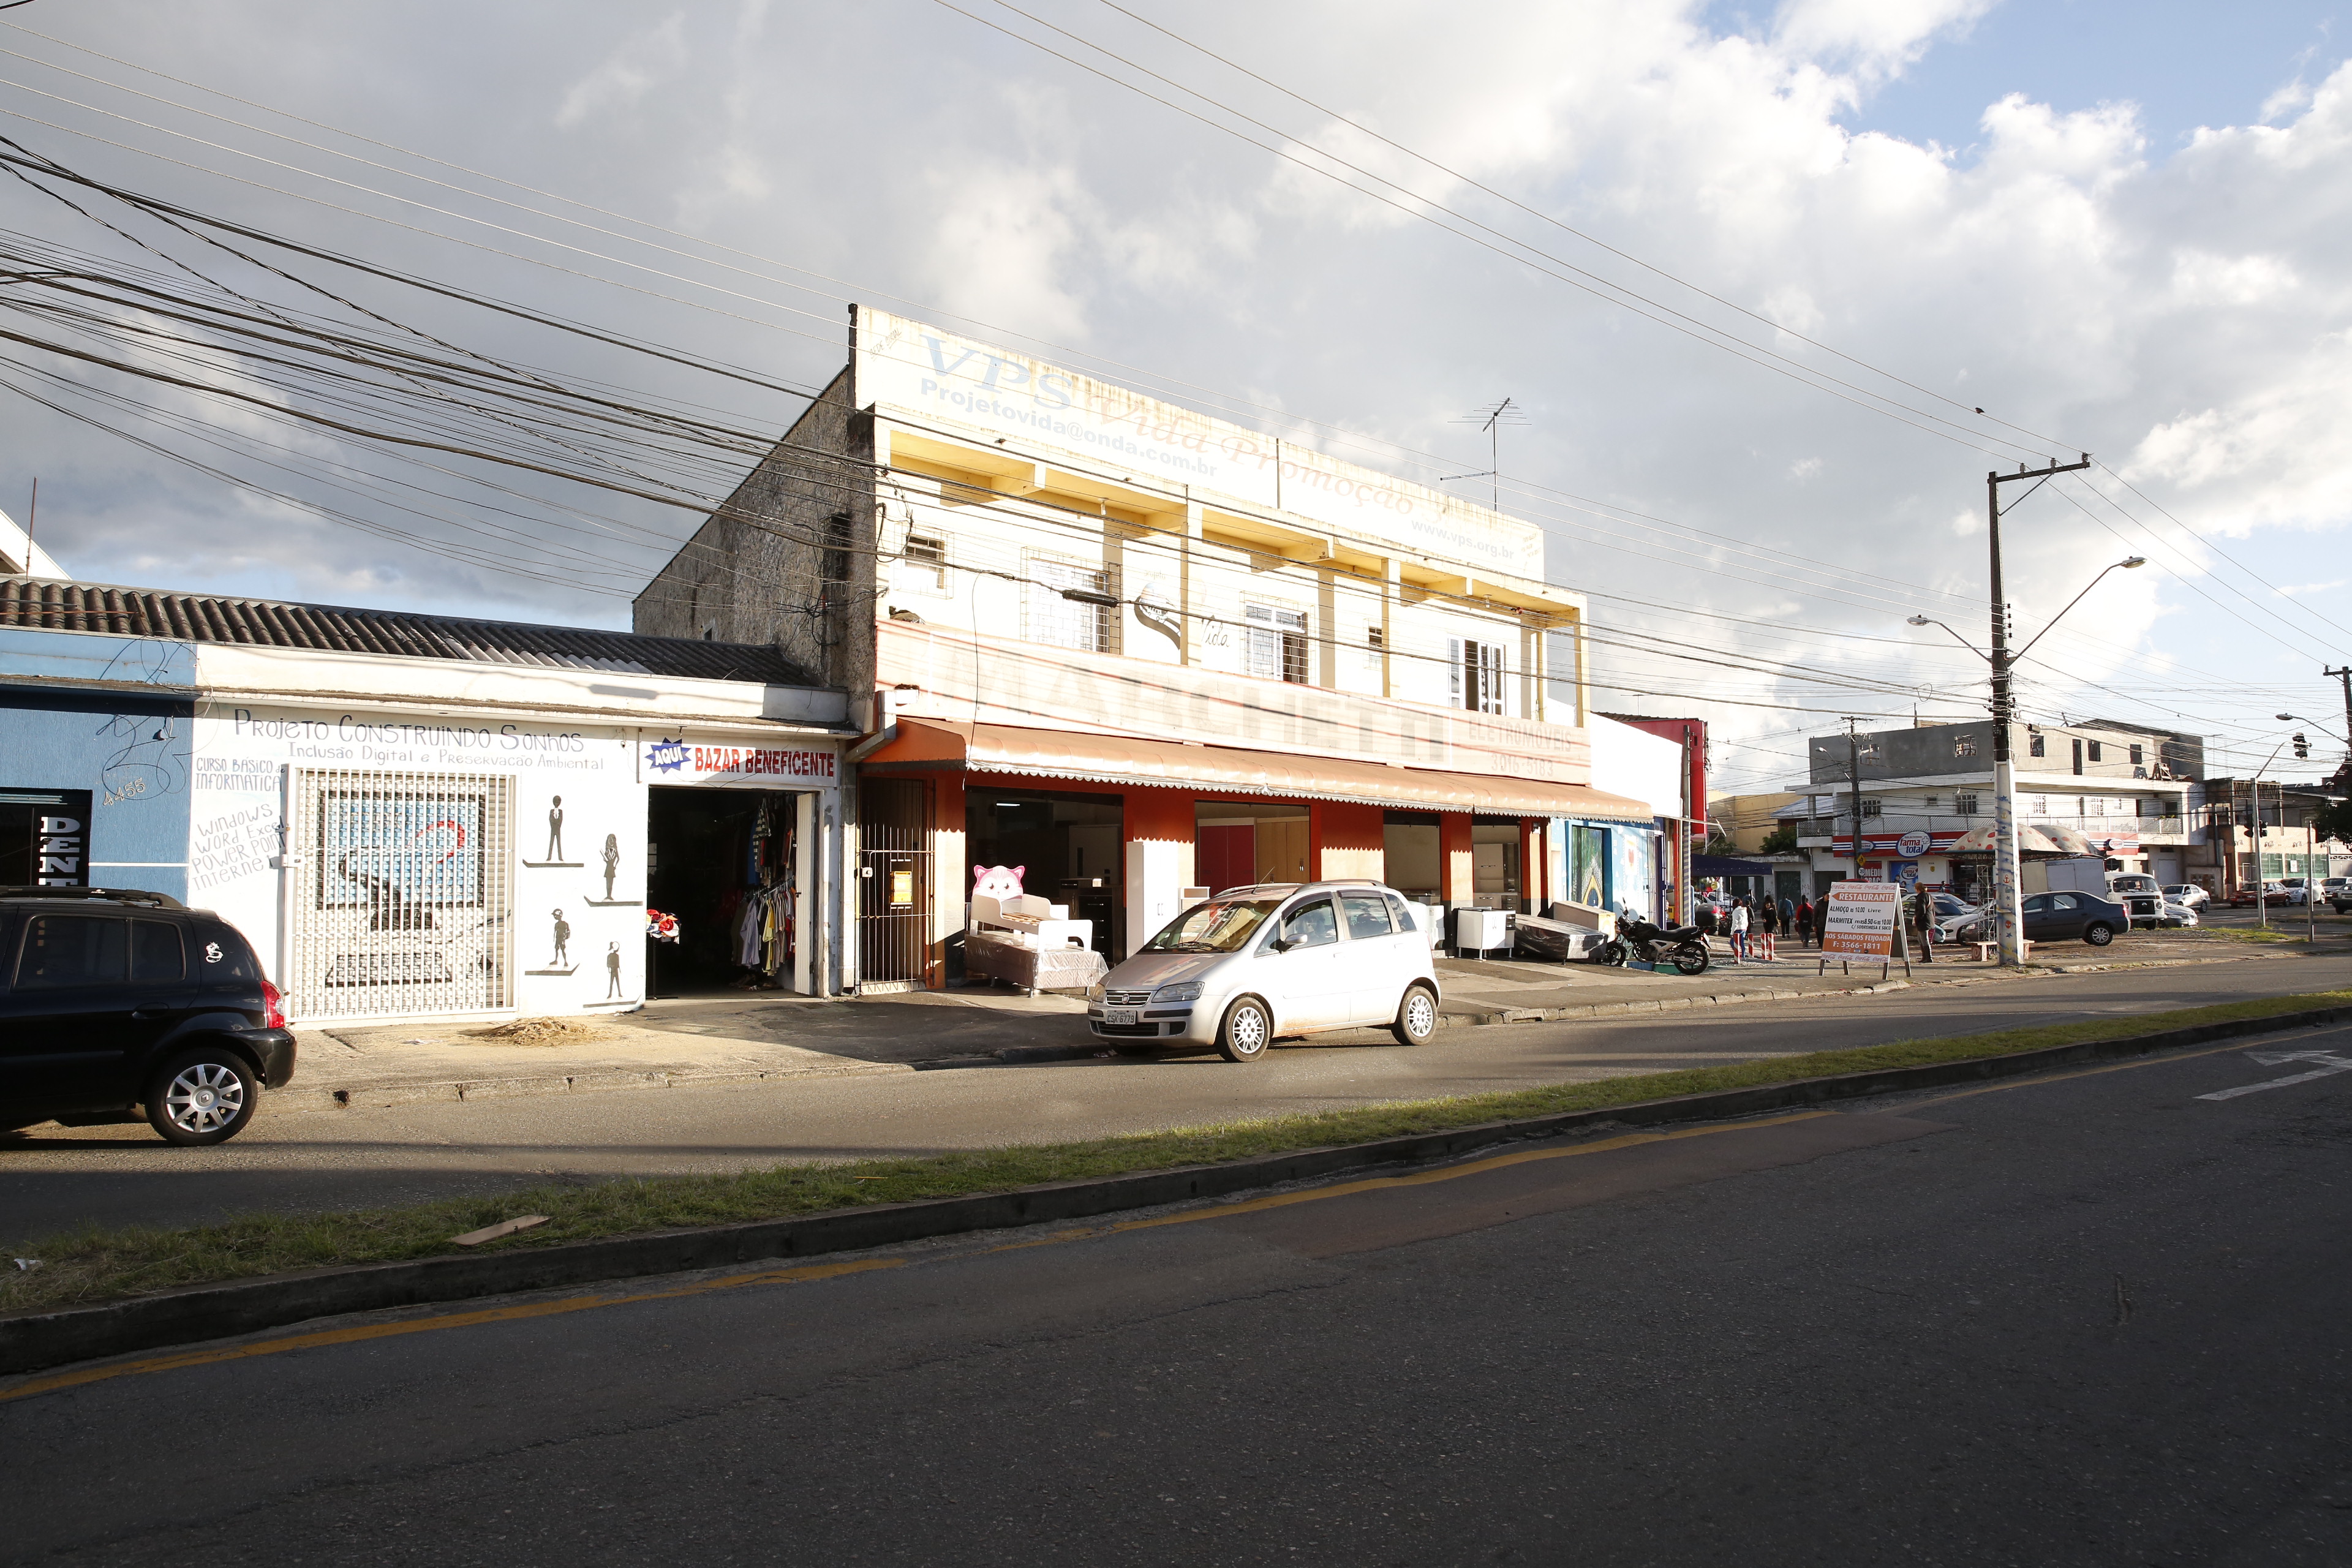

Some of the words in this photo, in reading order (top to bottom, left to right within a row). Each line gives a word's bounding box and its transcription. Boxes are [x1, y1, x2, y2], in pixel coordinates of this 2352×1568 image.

[919, 333, 1073, 410] VPS
[1087, 395, 1208, 453] Vida
[1221, 436, 1414, 514] Promoção
[921, 378, 1218, 477] Projetovida@onda.com.br
[1411, 519, 1514, 559] www.vps.org.br
[1468, 717, 1572, 753] ELETROMÓVEIS
[197, 758, 227, 772] CURSO
[288, 742, 353, 759] Inclusão
[361, 745, 413, 766] Digital
[421, 754, 430, 763] e
[537, 754, 604, 770] Ambiental
[655, 745, 683, 766] AQUI
[695, 747, 741, 774] BAZAR
[745, 750, 835, 778] BENEFICENTE
[1491, 753, 1555, 777] 3016-5183
[103, 777, 146, 807] 4455
[1906, 845, 1923, 854] total
[1839, 893, 1894, 902] RESTAURANTE
